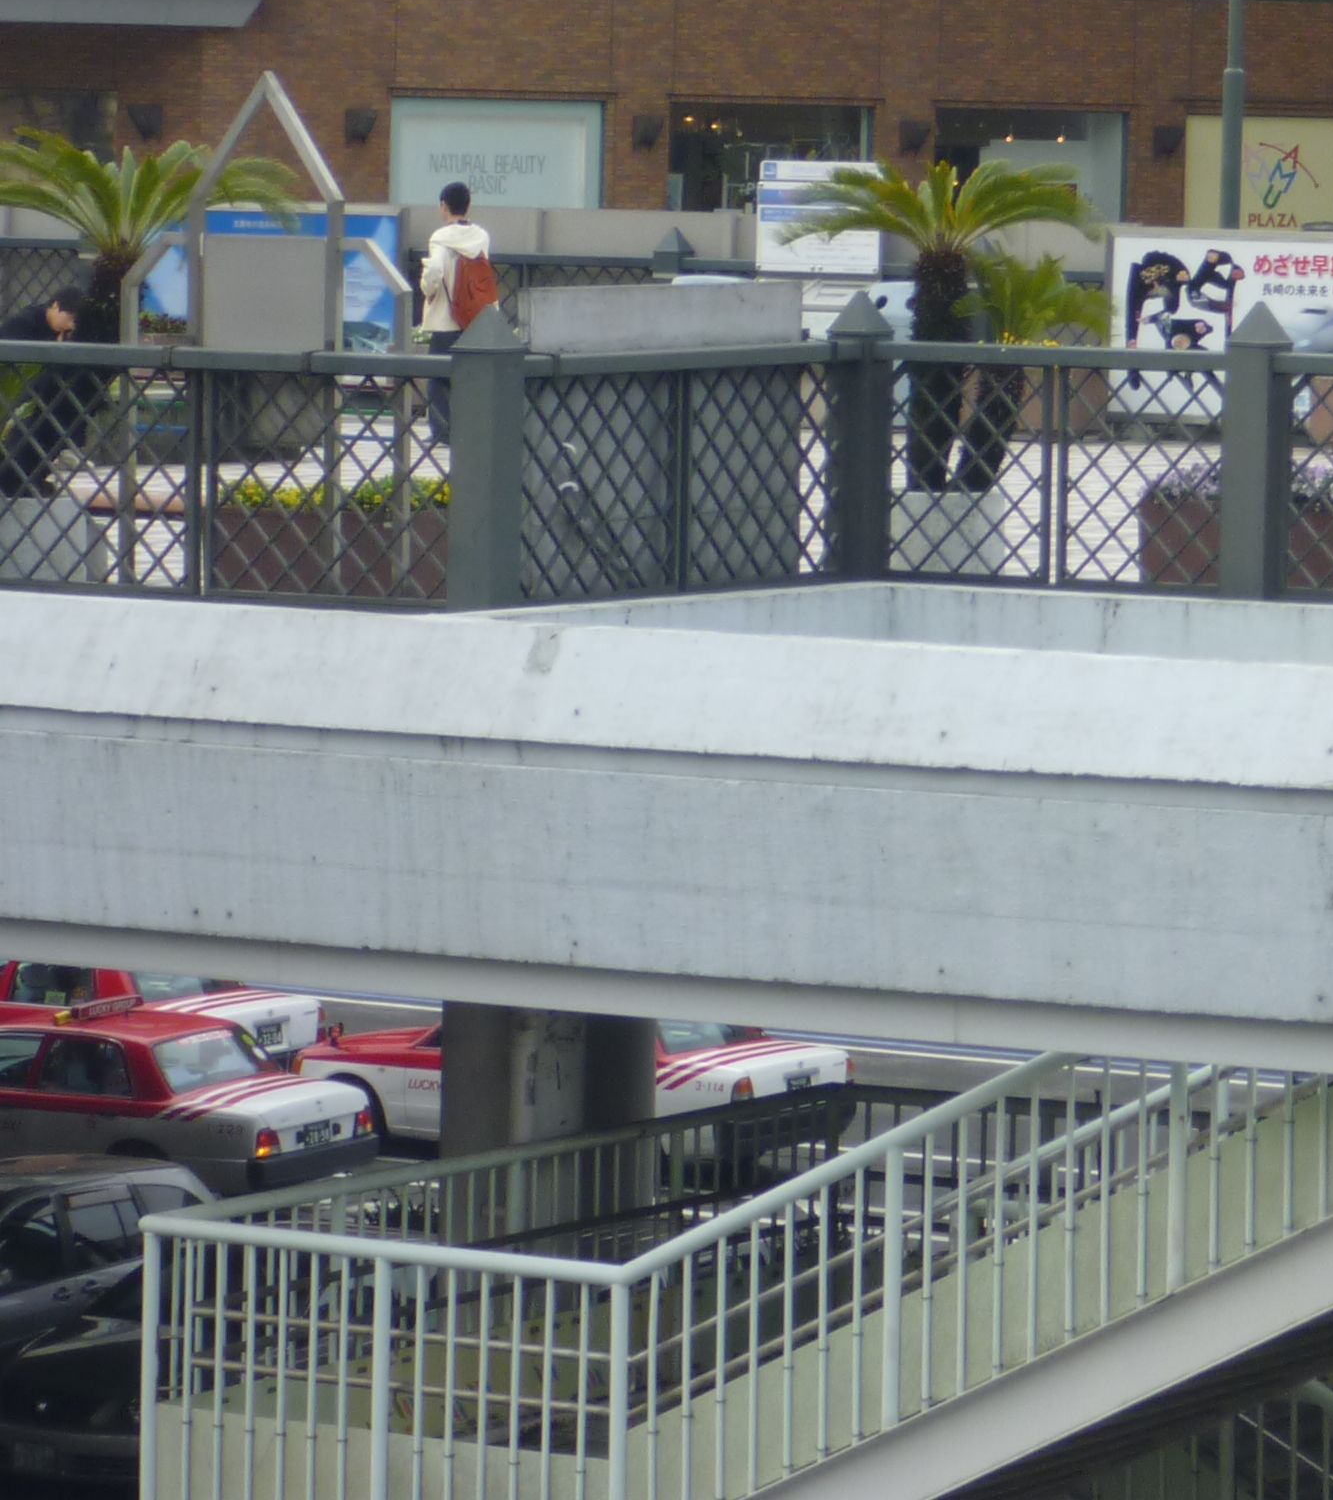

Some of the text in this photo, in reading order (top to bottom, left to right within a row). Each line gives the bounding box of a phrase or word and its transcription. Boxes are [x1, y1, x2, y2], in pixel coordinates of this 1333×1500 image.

[429, 153, 546, 175] NATURAL BEAUTY
[468, 174, 507, 195] BASIC
[1247, 212, 1298, 229] PLAZA
